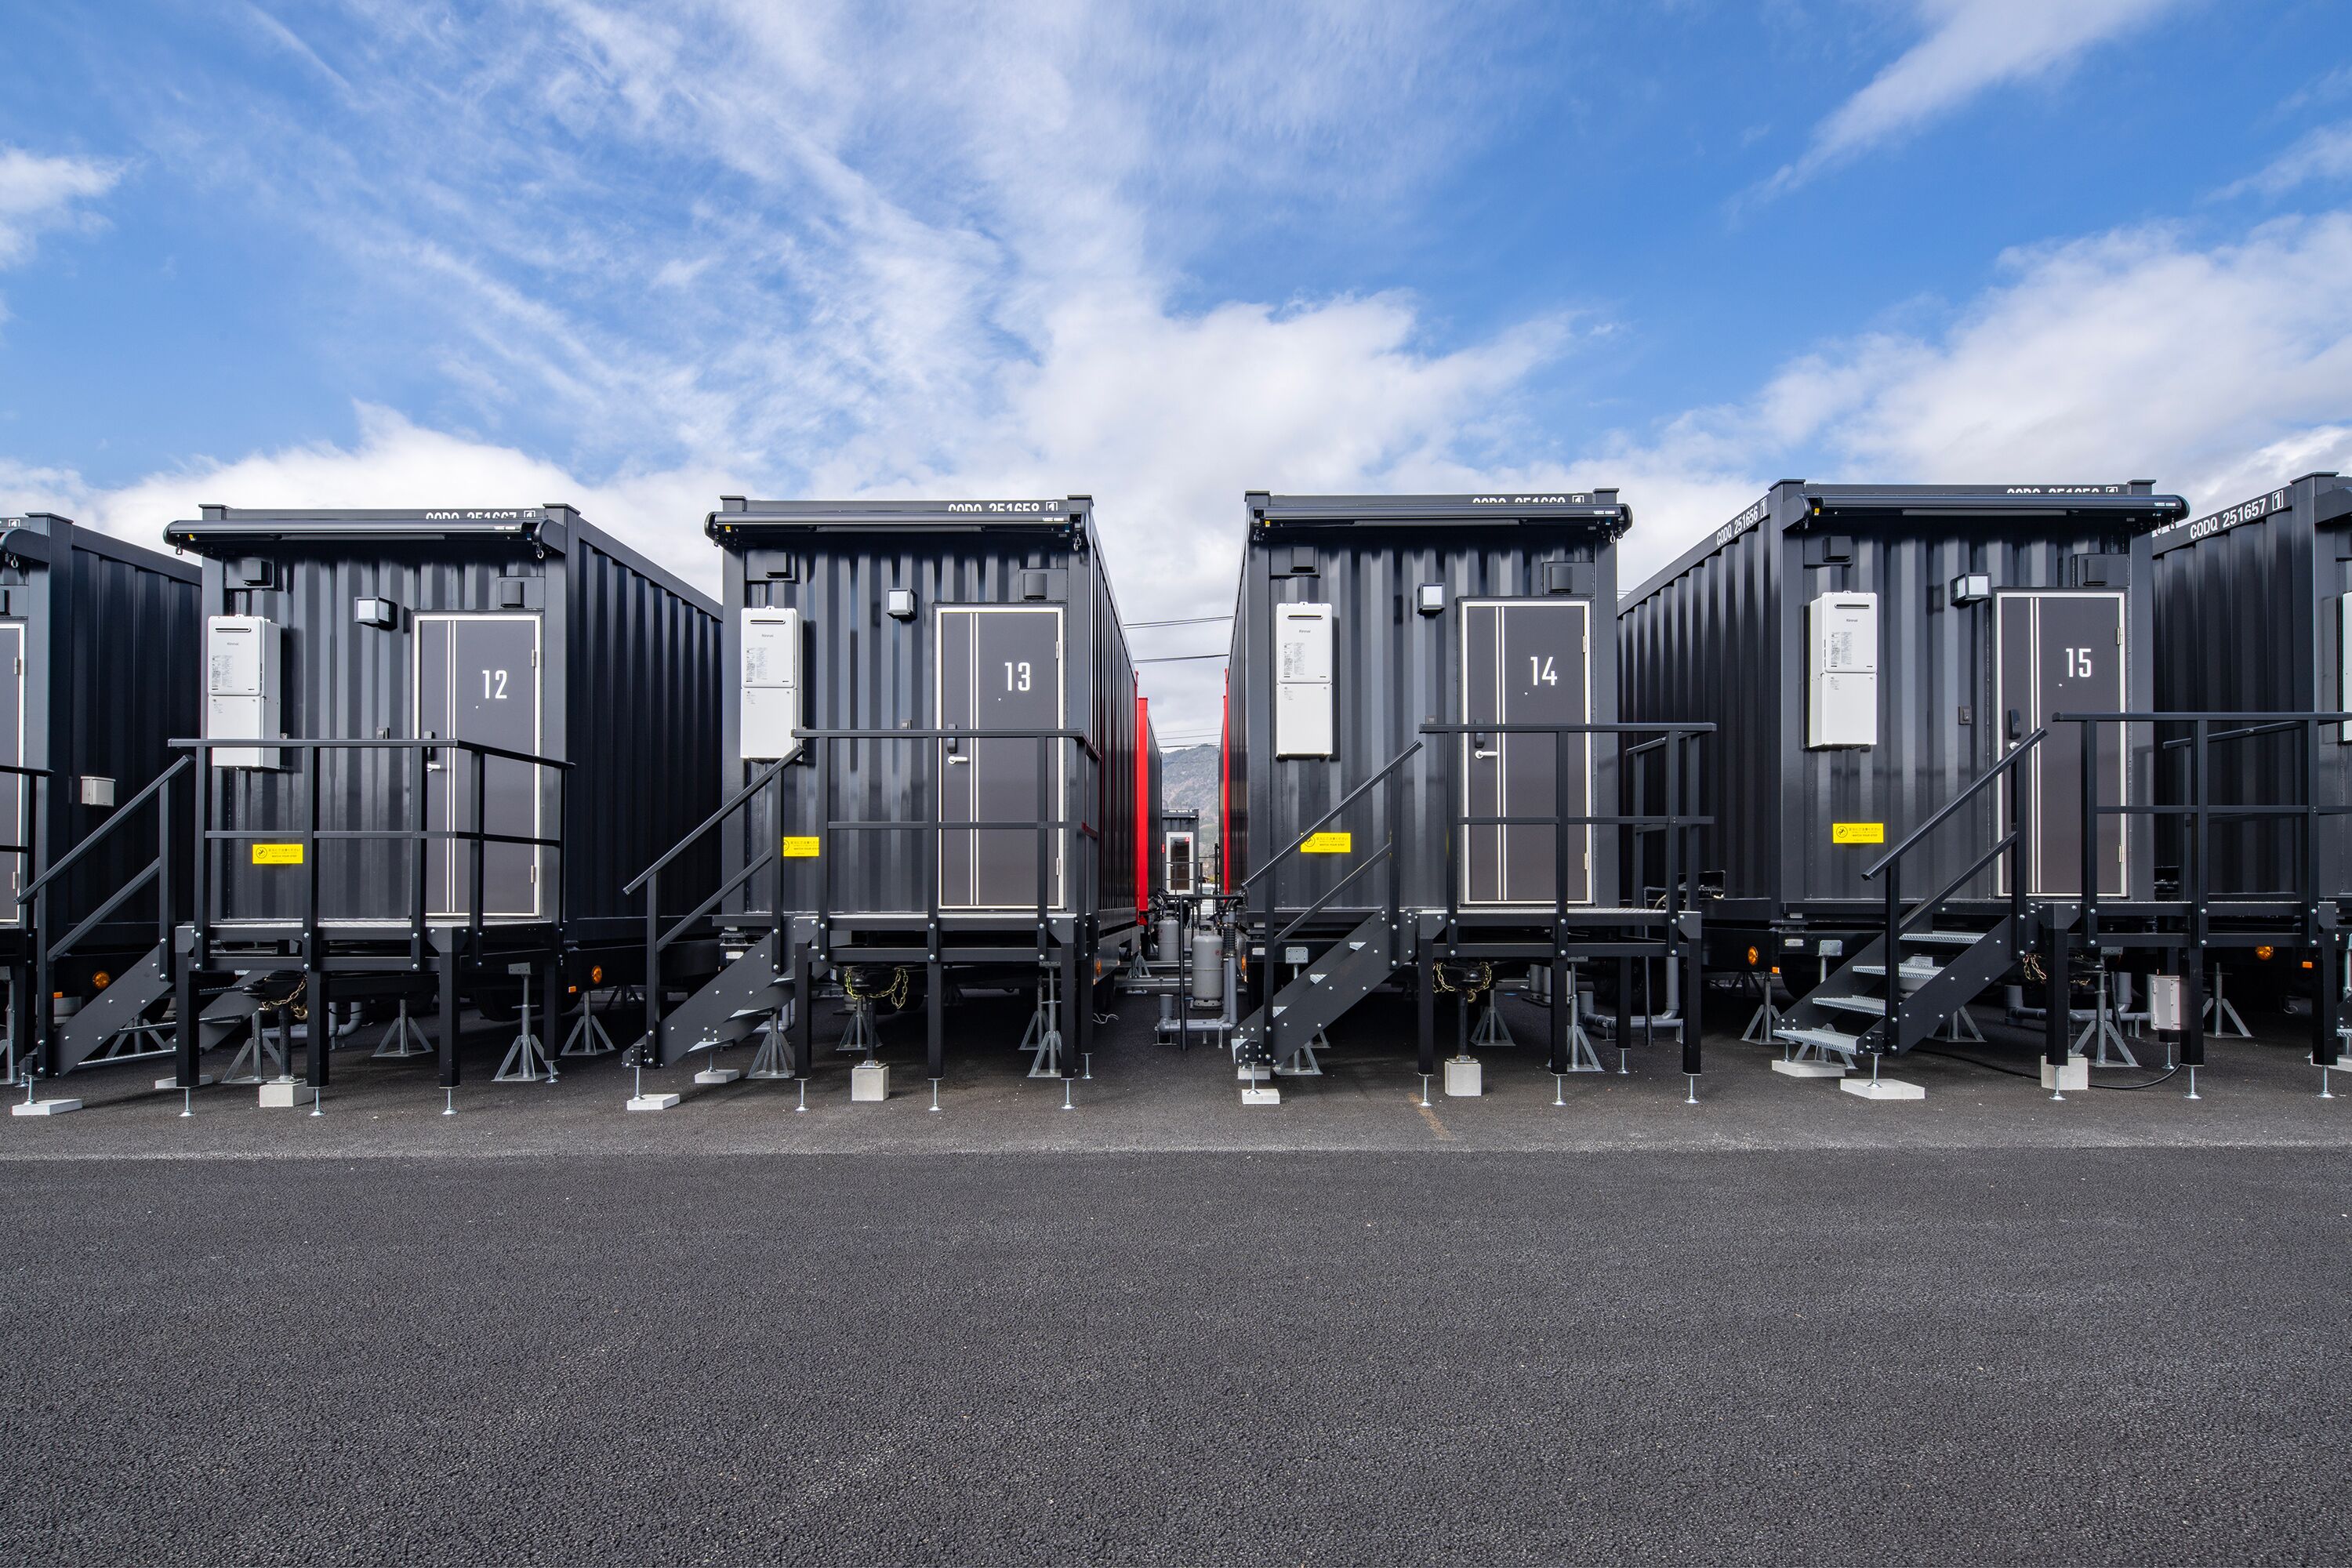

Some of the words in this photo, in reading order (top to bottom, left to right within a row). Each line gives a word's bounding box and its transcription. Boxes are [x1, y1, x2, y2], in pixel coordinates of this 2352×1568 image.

[1717, 524, 1732, 546] CODQ
[1734, 506, 1758, 535] 251656
[2190, 517, 2218, 539] CODQ
[2222, 498, 2267, 528] 251657
[2274, 492, 2282, 509] 1
[1004, 662, 1031, 691] 13
[1530, 656, 1558, 686] 14
[2065, 648, 2092, 677] 15
[481, 670, 508, 699] 12
